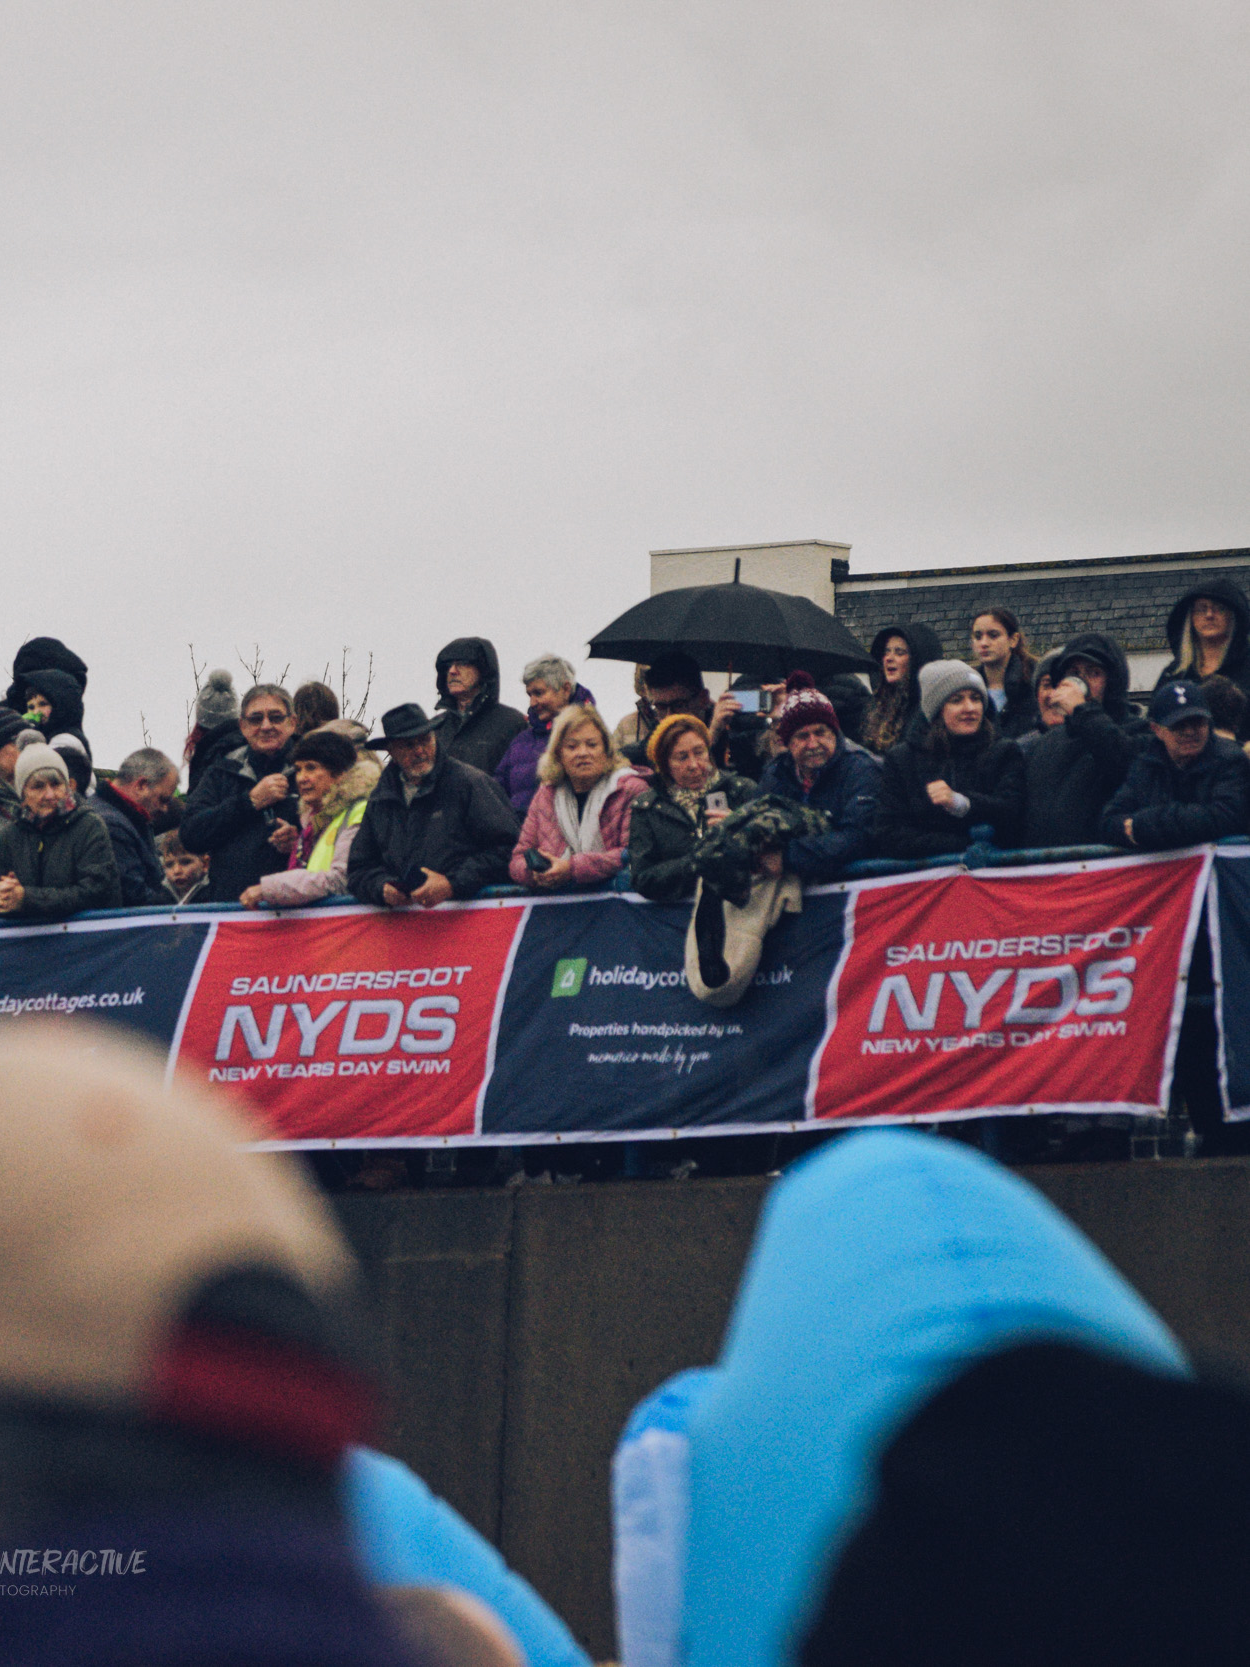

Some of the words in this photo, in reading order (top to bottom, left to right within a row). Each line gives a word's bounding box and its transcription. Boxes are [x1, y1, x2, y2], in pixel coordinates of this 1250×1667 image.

[885, 926, 1153, 966] SAUNDERSFOOT
[230, 966, 472, 996] SAUNDERSFOOT
[867, 956, 1137, 1033] NYDS
[215, 995, 460, 1061] NYDS
[568, 1022, 630, 1038] Properties
[631, 1021, 707, 1038] handpicked
[708, 1023, 725, 1038] by
[861, 1037, 920, 1055] NEW
[924, 1031, 1005, 1052] YEARS
[1009, 1026, 1058, 1047] DAY
[1057, 1020, 1127, 1039] SWIM
[208, 1066, 262, 1082] NEW
[265, 1062, 335, 1078] YEARS
[338, 1060, 383, 1076] DAY
[386, 1059, 451, 1075] SWIM
